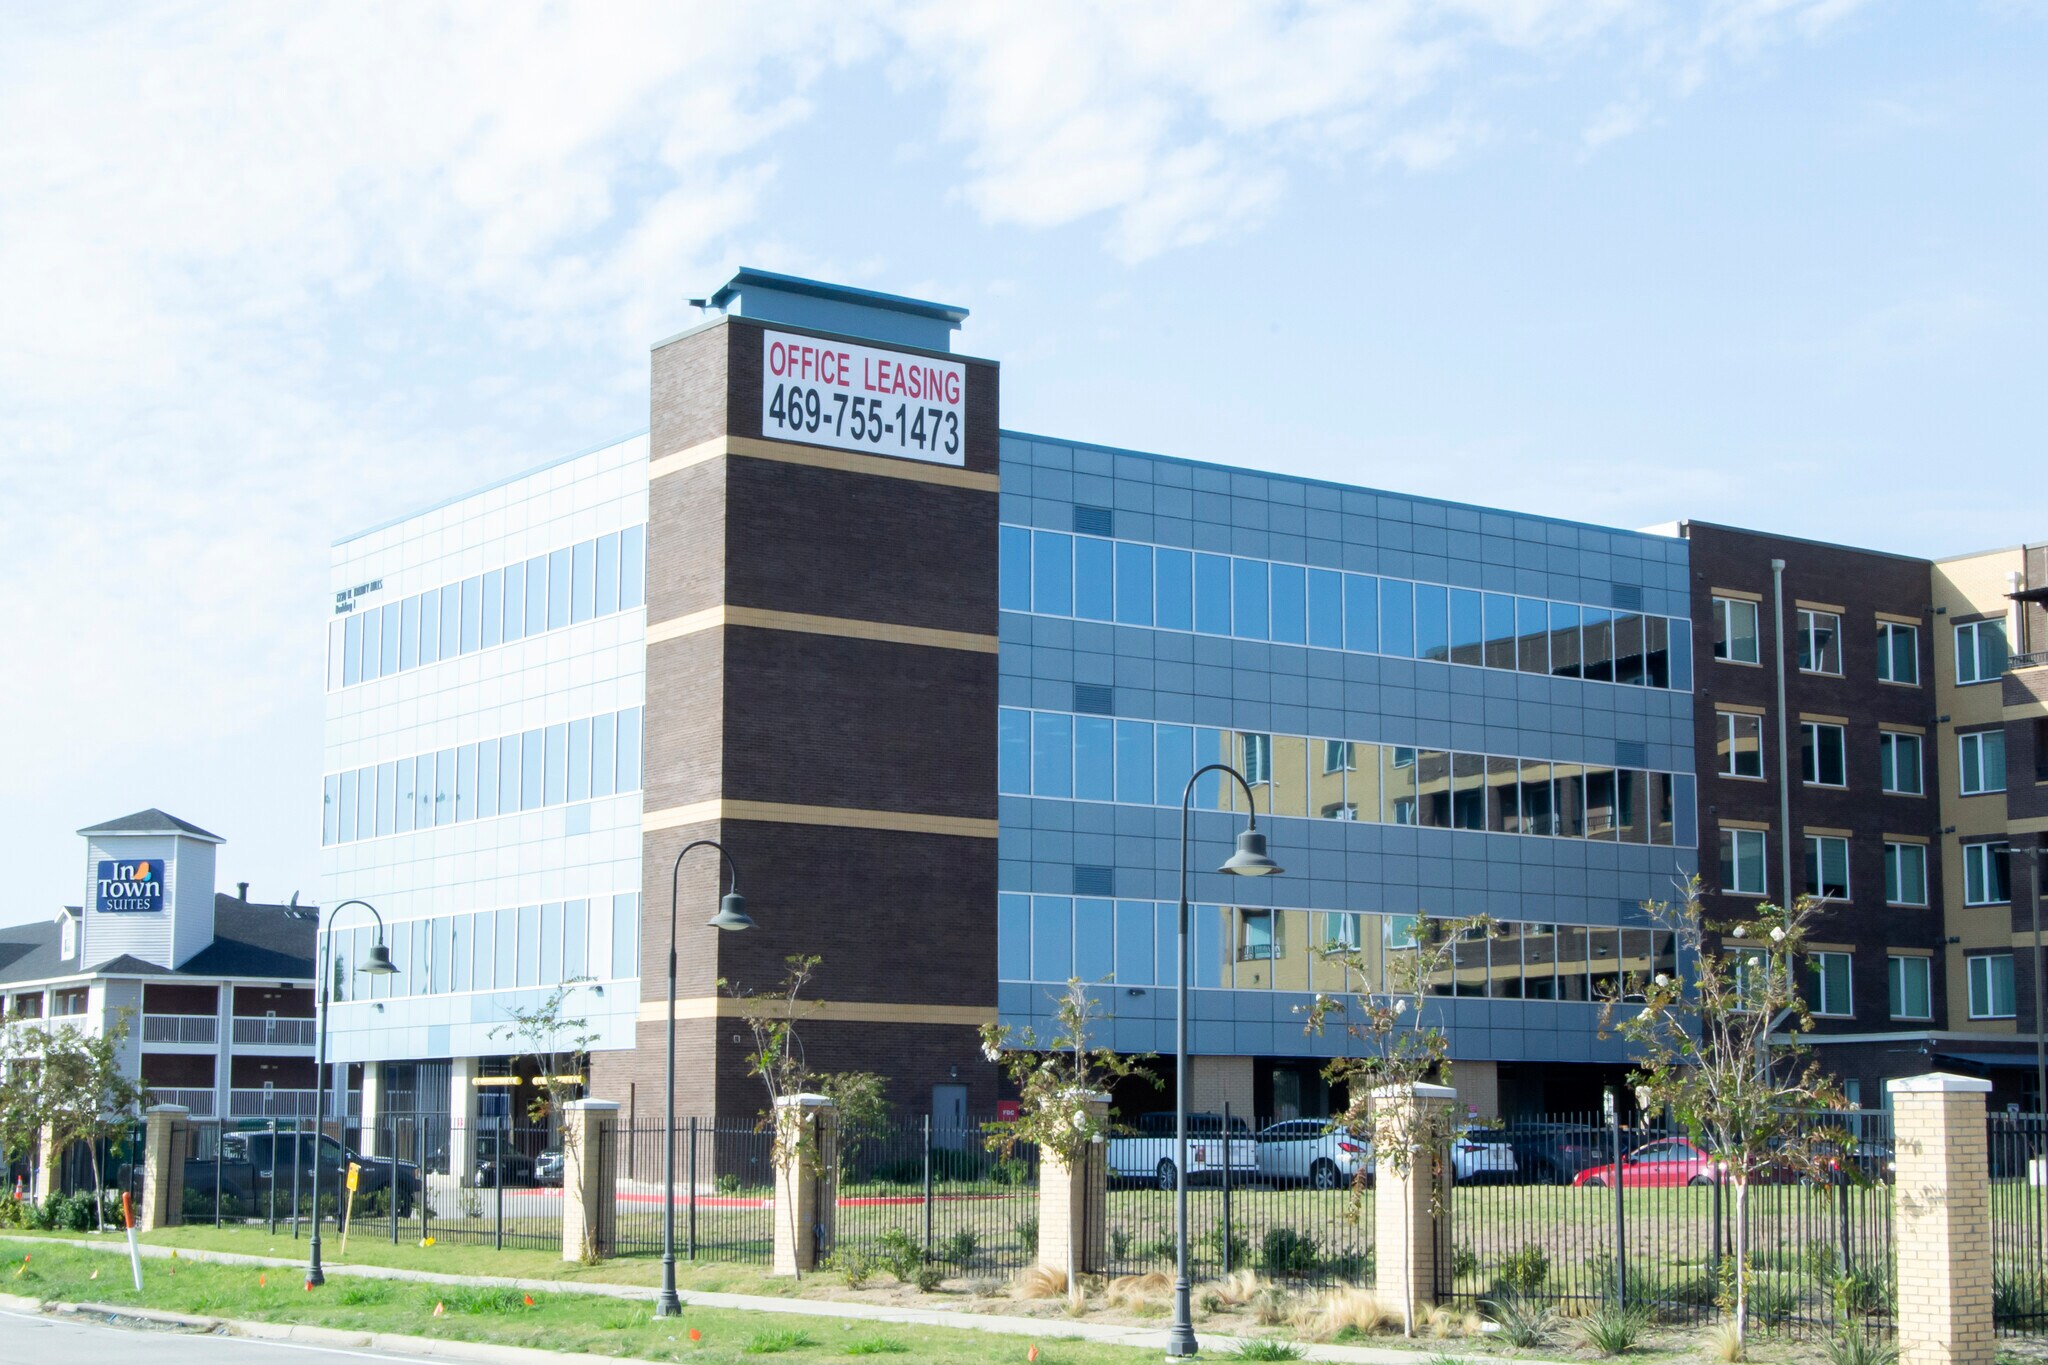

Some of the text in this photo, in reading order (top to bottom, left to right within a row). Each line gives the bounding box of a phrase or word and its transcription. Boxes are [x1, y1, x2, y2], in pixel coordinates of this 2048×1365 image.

[770, 341, 960, 405] OFFICE LEASING
[769, 383, 959, 455] 469-755-1473
[113, 862, 134, 881] In
[106, 898, 151, 911] SUITES
